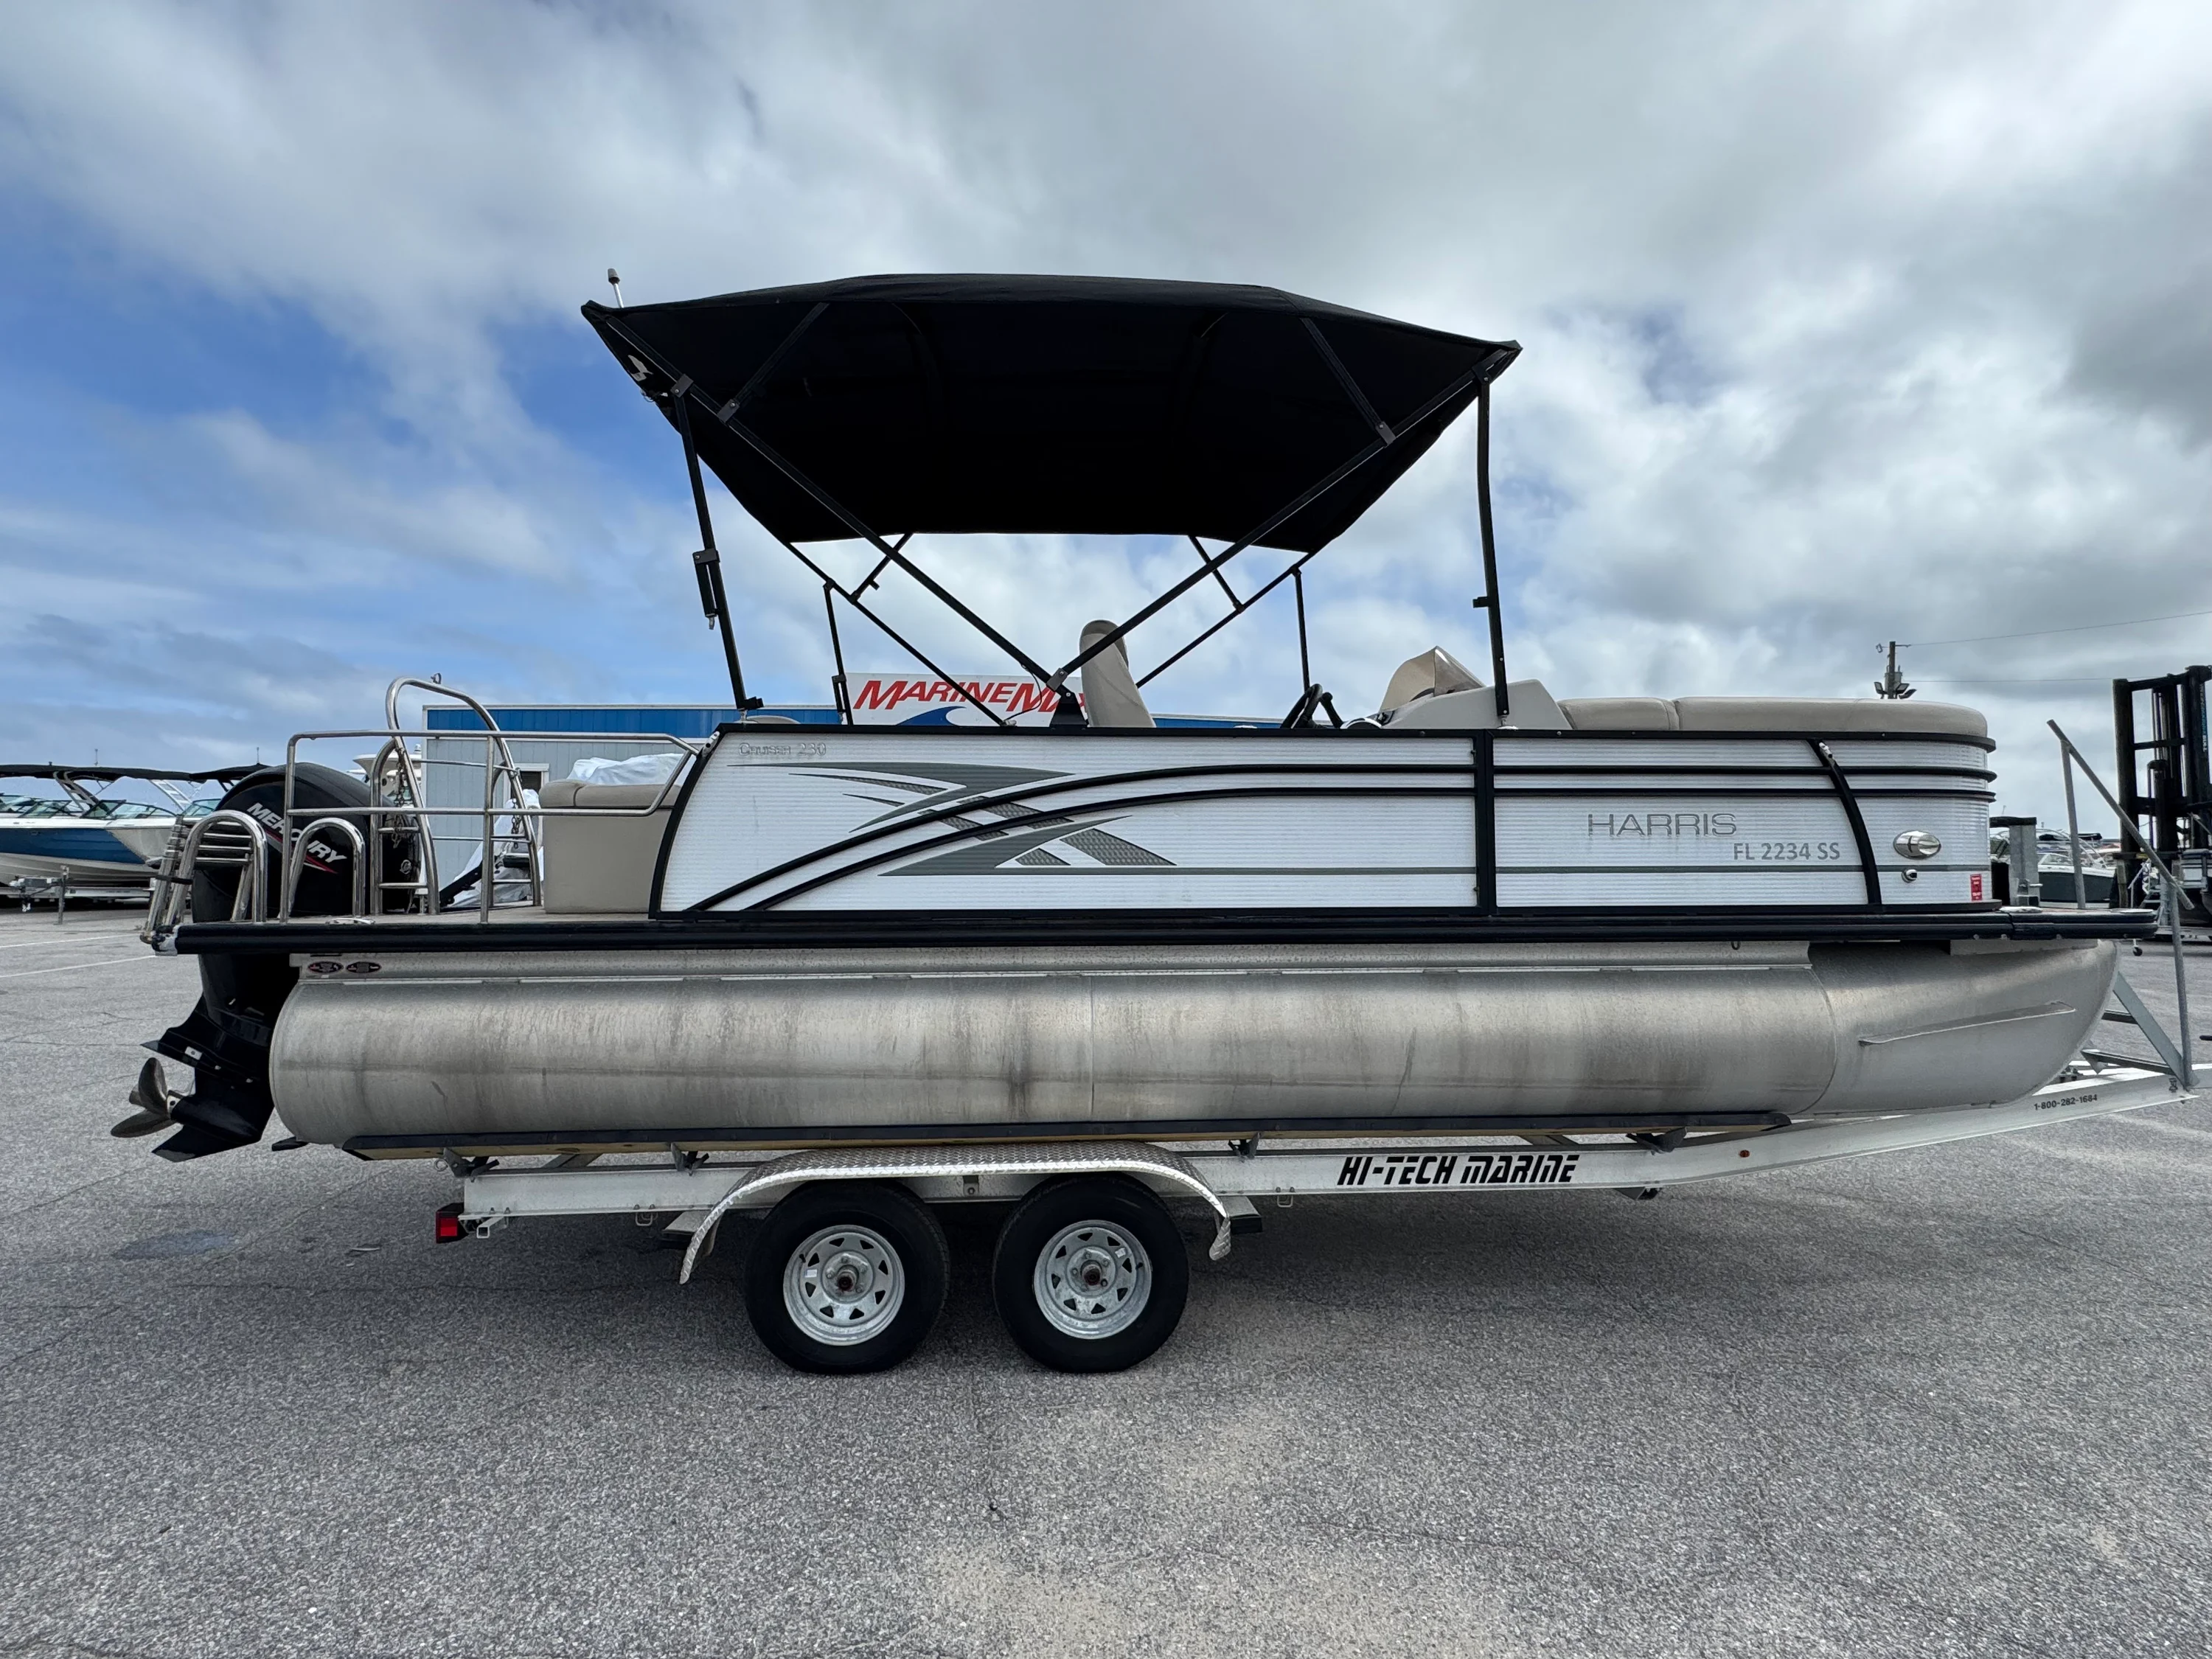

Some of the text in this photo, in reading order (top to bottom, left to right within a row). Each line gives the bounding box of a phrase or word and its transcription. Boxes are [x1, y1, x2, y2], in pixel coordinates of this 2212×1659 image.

[852, 681, 1085, 712] MARINEM
[797, 742, 826, 756] 230
[1588, 813, 1736, 836] HARRIS
[1734, 842, 1840, 860] FL 2234 SS
[2034, 1094, 2097, 1110] 1-800-282-1684
[1337, 1154, 1580, 1186] HI-TECH MARINE
